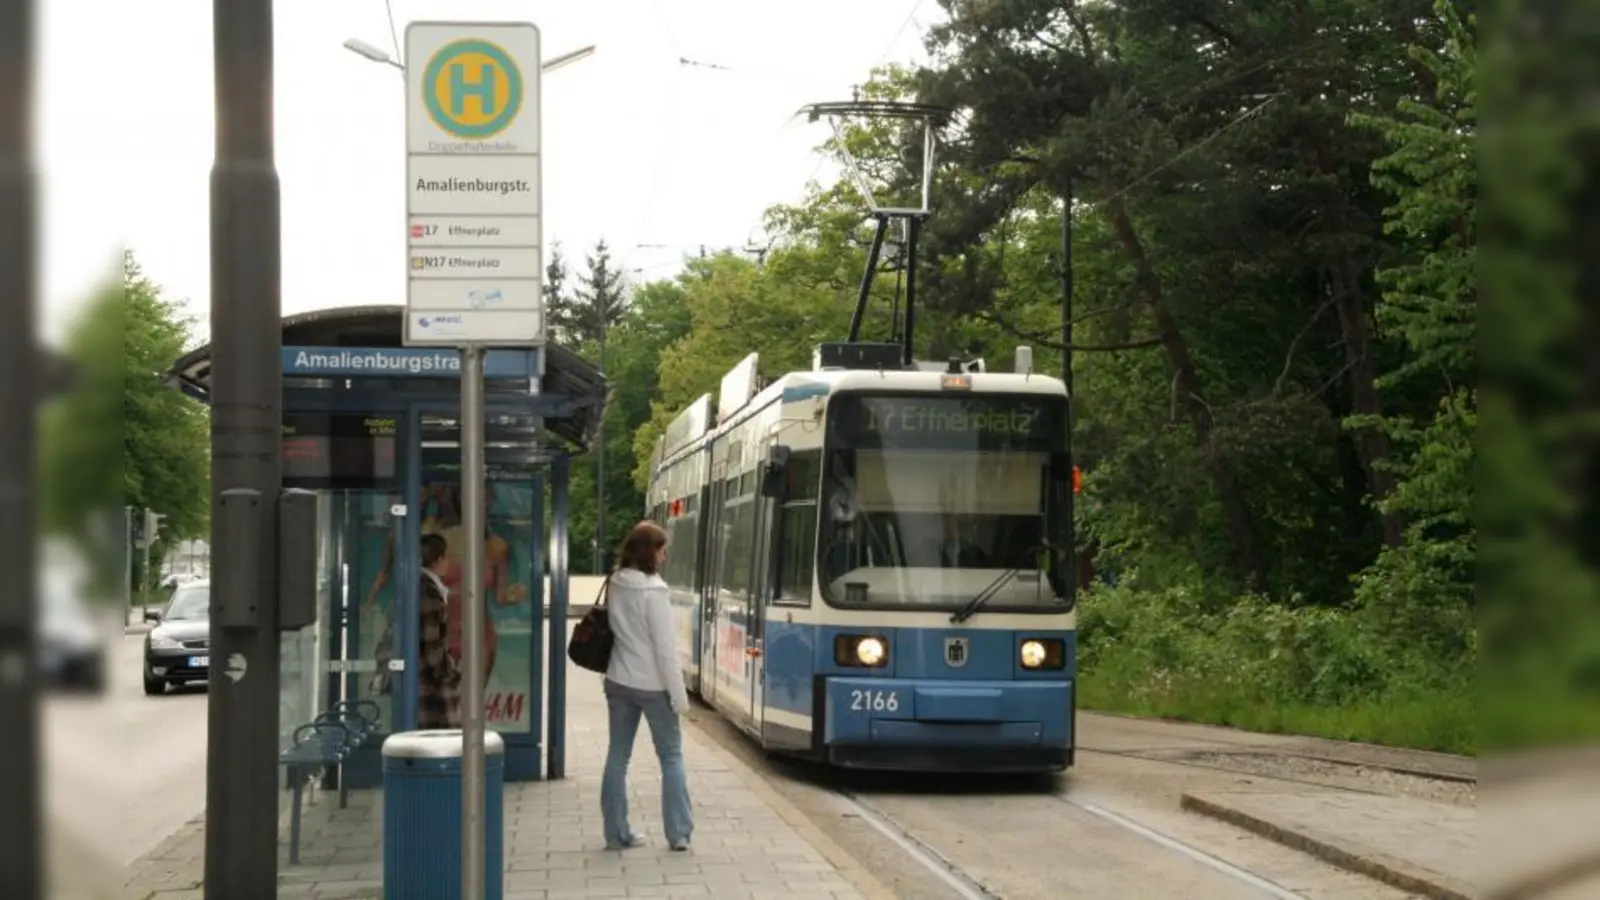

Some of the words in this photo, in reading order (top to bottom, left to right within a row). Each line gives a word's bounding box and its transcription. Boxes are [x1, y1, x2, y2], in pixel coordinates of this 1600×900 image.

[450, 63, 495, 115] H
[416, 176, 531, 195] Amalienburgstr.
[424, 224, 439, 236] 17
[448, 224, 501, 238] Effnerplatz
[424, 255, 446, 268] N17
[448, 255, 501, 269] Effnerplatz
[294, 350, 461, 372] Amalienburgstra
[901, 404, 1034, 433] Effnerplatz
[850, 689, 899, 712] 2166
